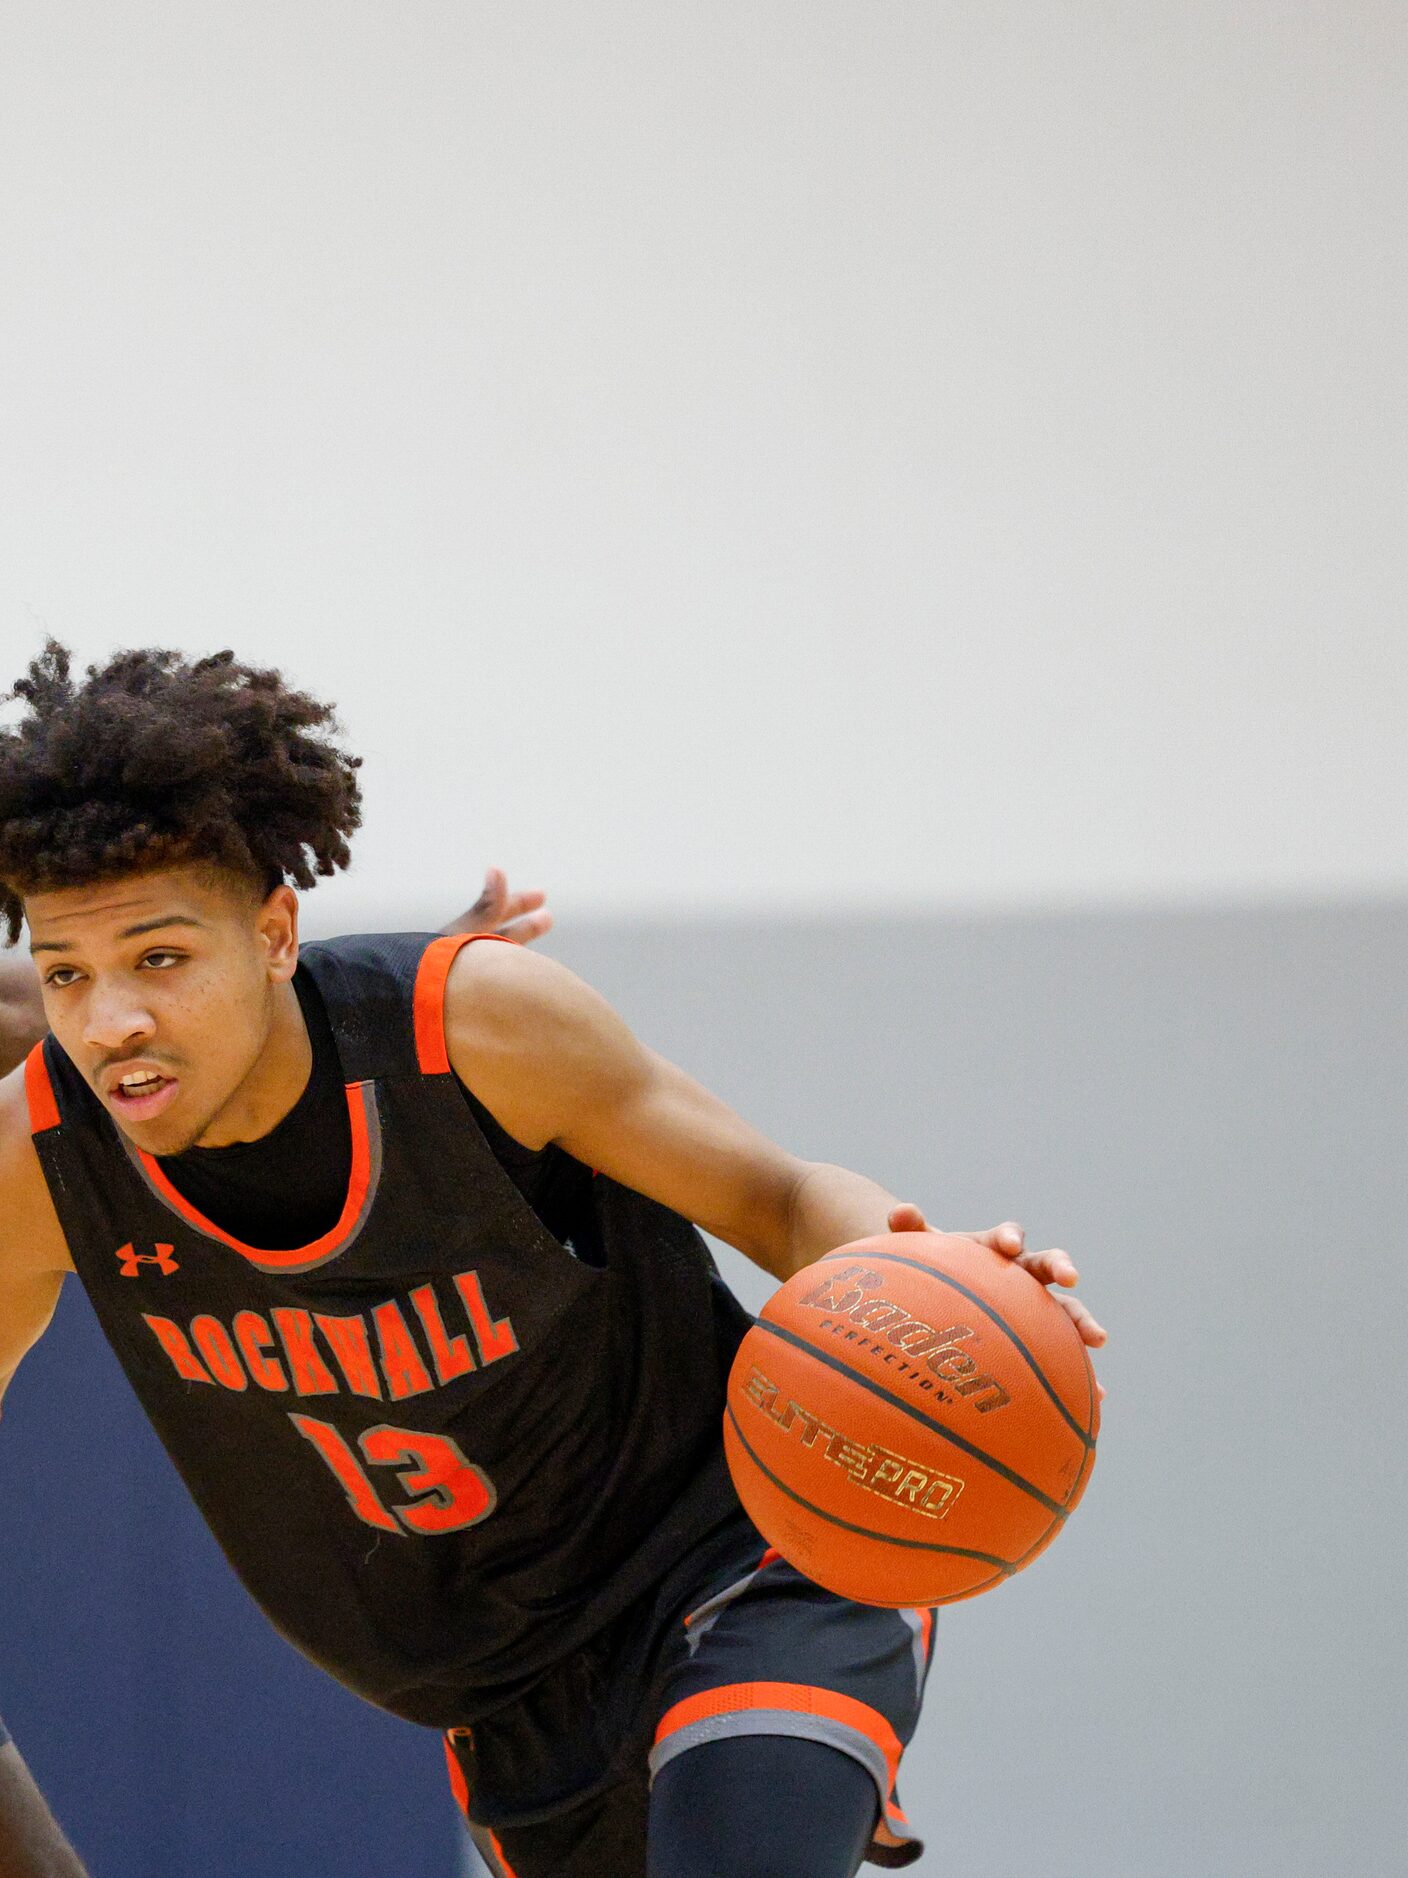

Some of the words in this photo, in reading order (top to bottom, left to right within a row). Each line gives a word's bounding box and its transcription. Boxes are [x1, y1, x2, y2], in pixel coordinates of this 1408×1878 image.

[141, 1269, 520, 1401] ROCKWALL
[798, 1265, 1012, 1414] Baden
[818, 1319, 954, 1405] PERFECTION
[287, 1411, 498, 1537] 13
[742, 1364, 874, 1481] ELITE
[870, 1459, 954, 1511] PRO
